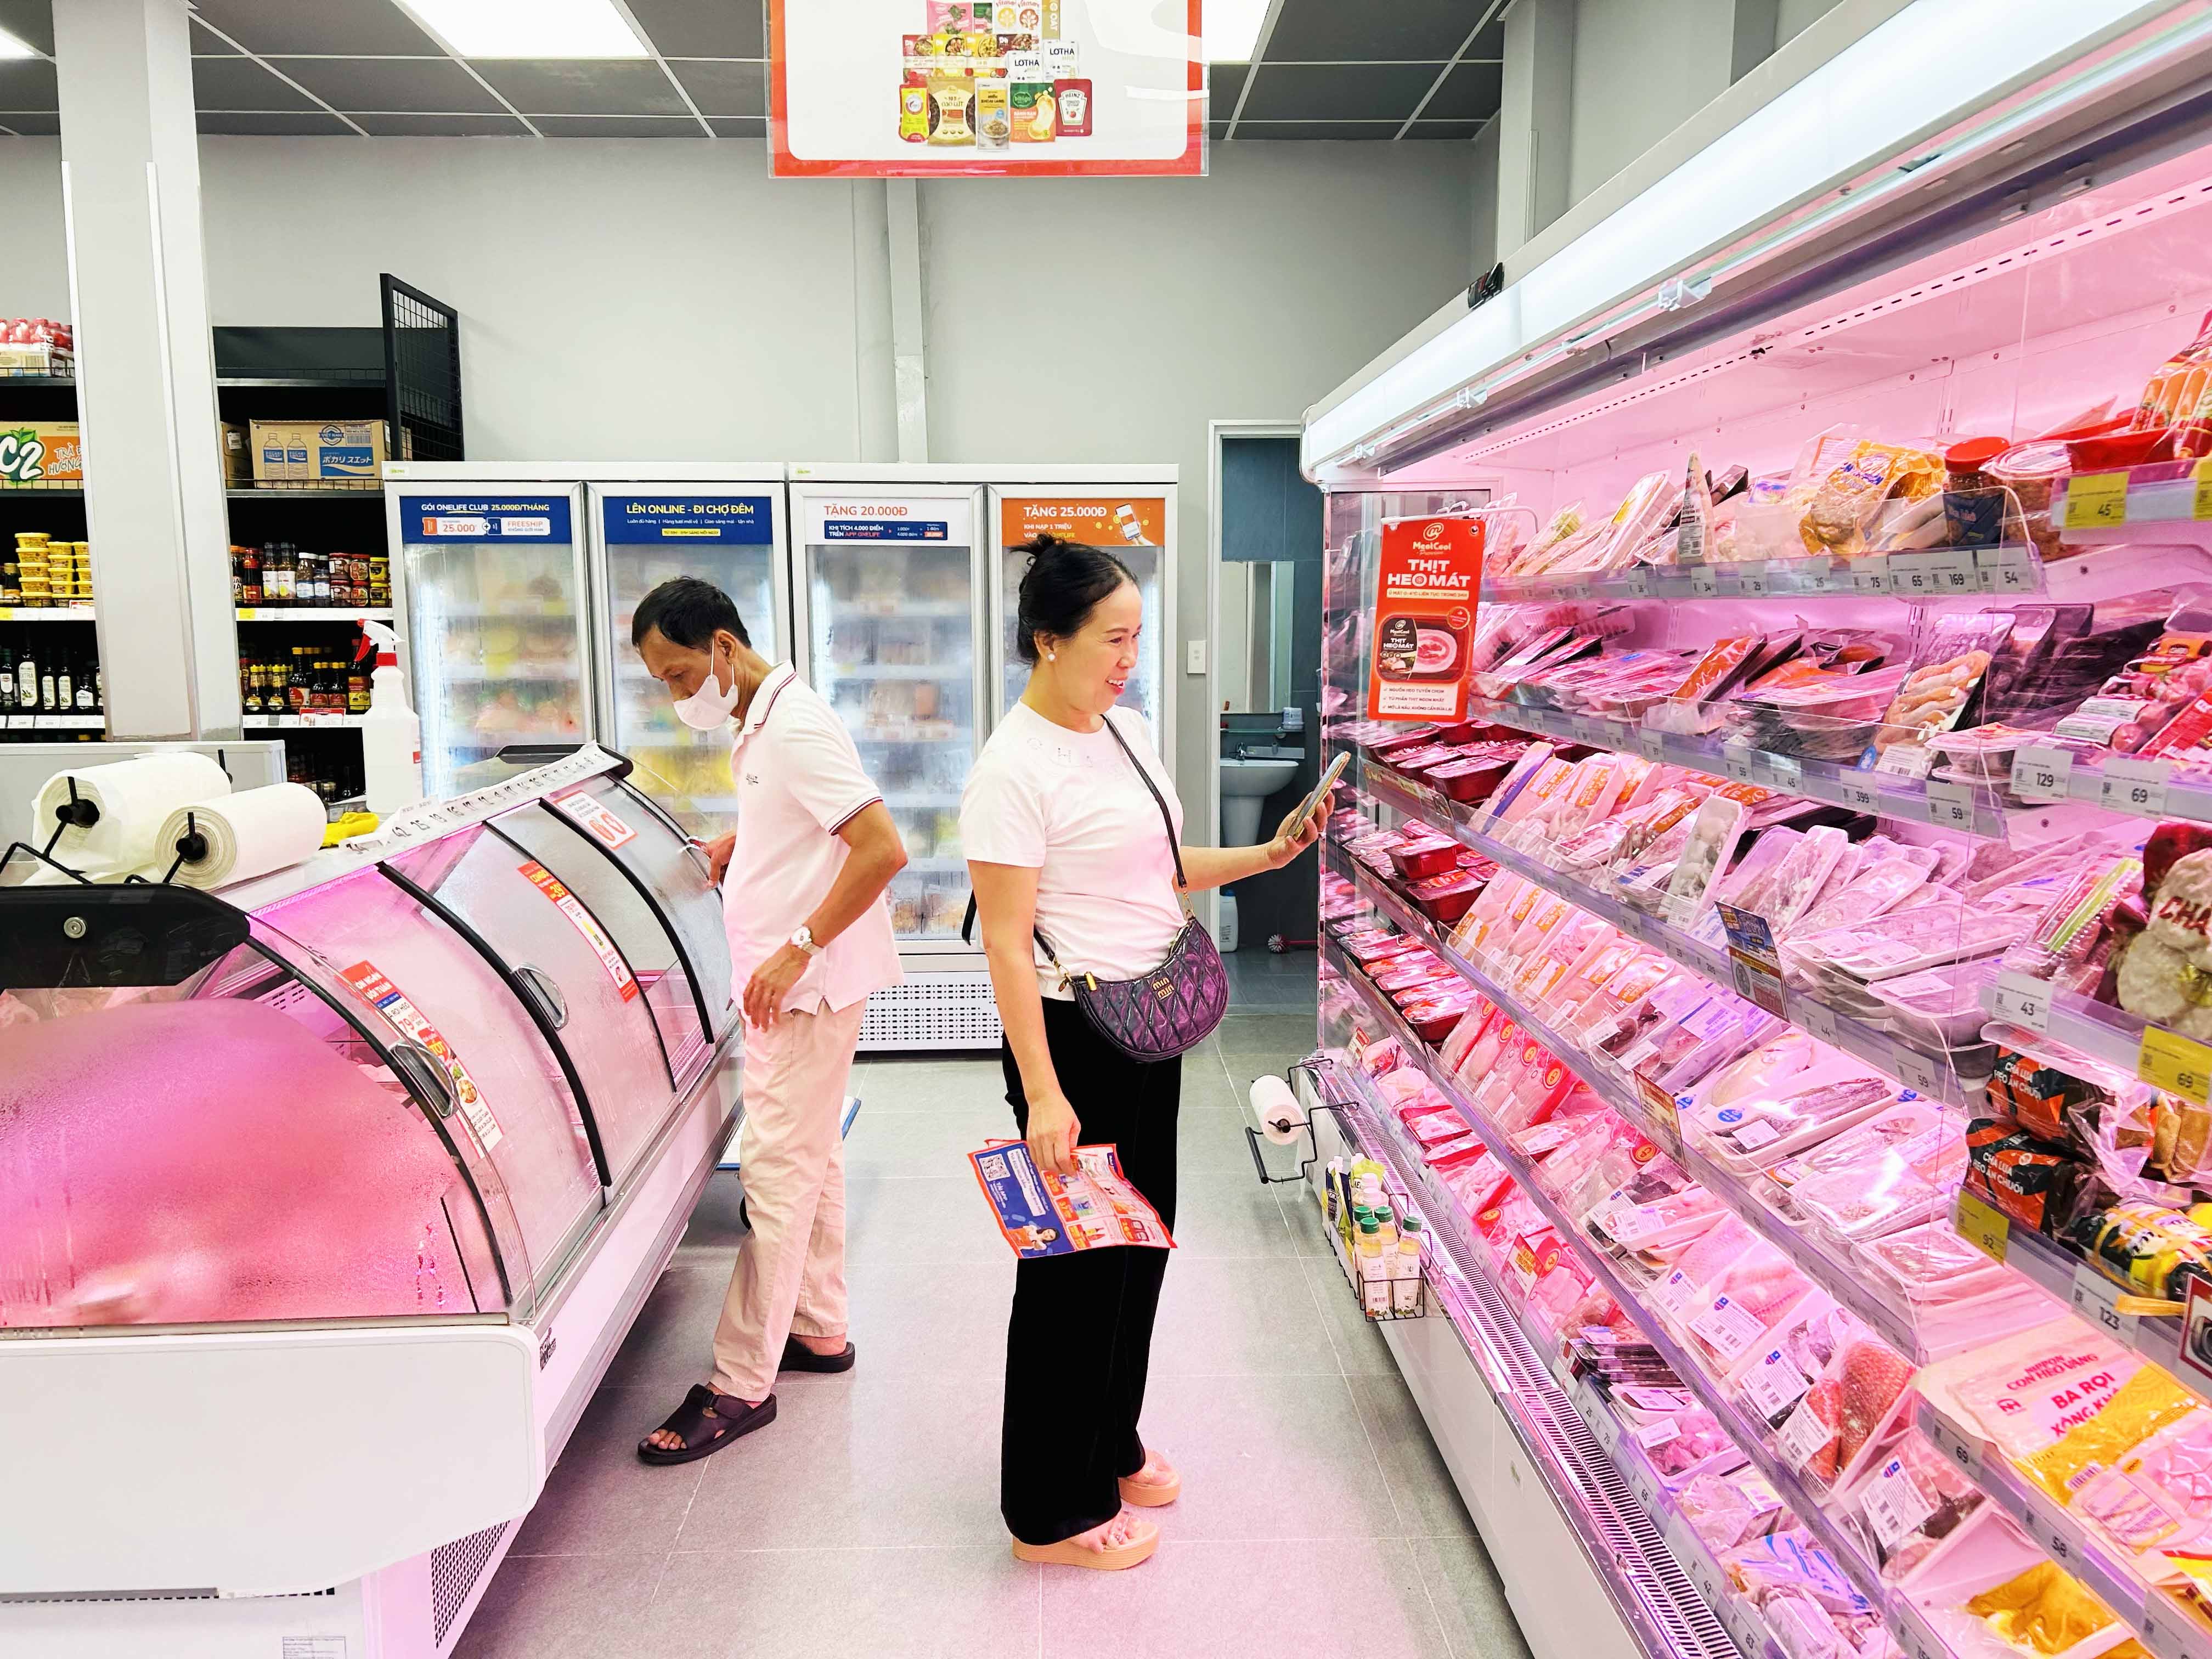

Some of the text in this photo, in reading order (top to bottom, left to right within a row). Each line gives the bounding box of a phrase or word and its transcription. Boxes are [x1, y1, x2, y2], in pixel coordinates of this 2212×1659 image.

[627, 503, 754, 516] LÊN ONLINE ĐI CHỢ ĐÊM
[824, 504, 908, 517] TẶNG 20.000Đ
[1023, 505, 1107, 520] TẶNG 25.000Đ
[2098, 504, 2111, 516] 45
[1413, 541, 1452, 551] MeatCool
[1407, 558, 1450, 574] THỊT
[1387, 572, 1471, 588] HEO MÁT
[1870, 572, 2018, 588] 75 65 169 54
[2036, 772, 2053, 787] 129
[1856, 791, 1870, 803] 399
[2131, 788, 2148, 803] 69
[1952, 808, 1963, 820] 59
[2021, 1002, 2035, 1015] 43
[2100, 1306, 2120, 1330] 123
[2024, 1355, 2064, 1372] NIPPON
[2006, 1353, 2098, 1391] CON HEO VÀNG
[2051, 1372, 2115, 1409] BA RỌI
